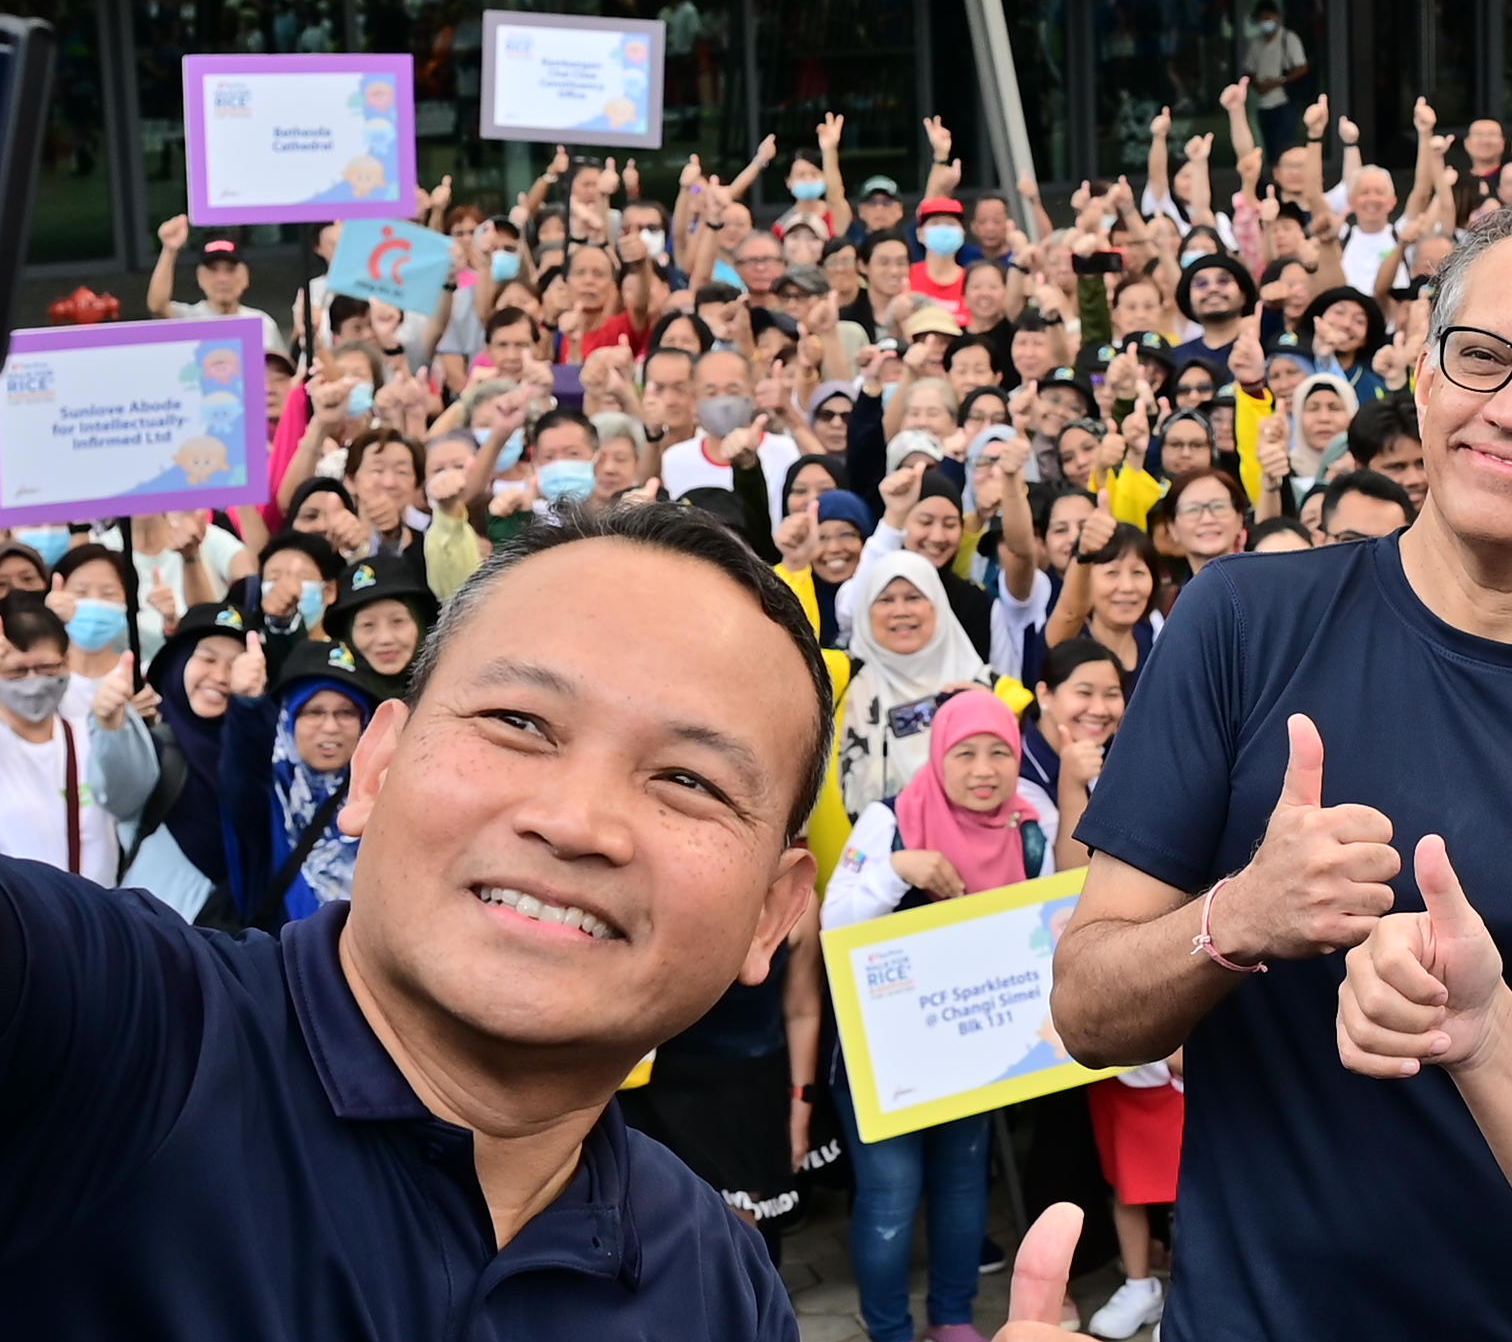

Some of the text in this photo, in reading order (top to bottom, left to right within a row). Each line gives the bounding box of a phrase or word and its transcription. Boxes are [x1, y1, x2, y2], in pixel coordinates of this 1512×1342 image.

[59, 398, 182, 420] Sunlove Abode
[52, 423, 75, 437] for
[72, 430, 172, 451] Infirmed Ltd
[919, 969, 1041, 1011] PCF Sparkletots
[925, 987, 1042, 1029] @ Changi Simei
[958, 1010, 1014, 1037] Blk 131
